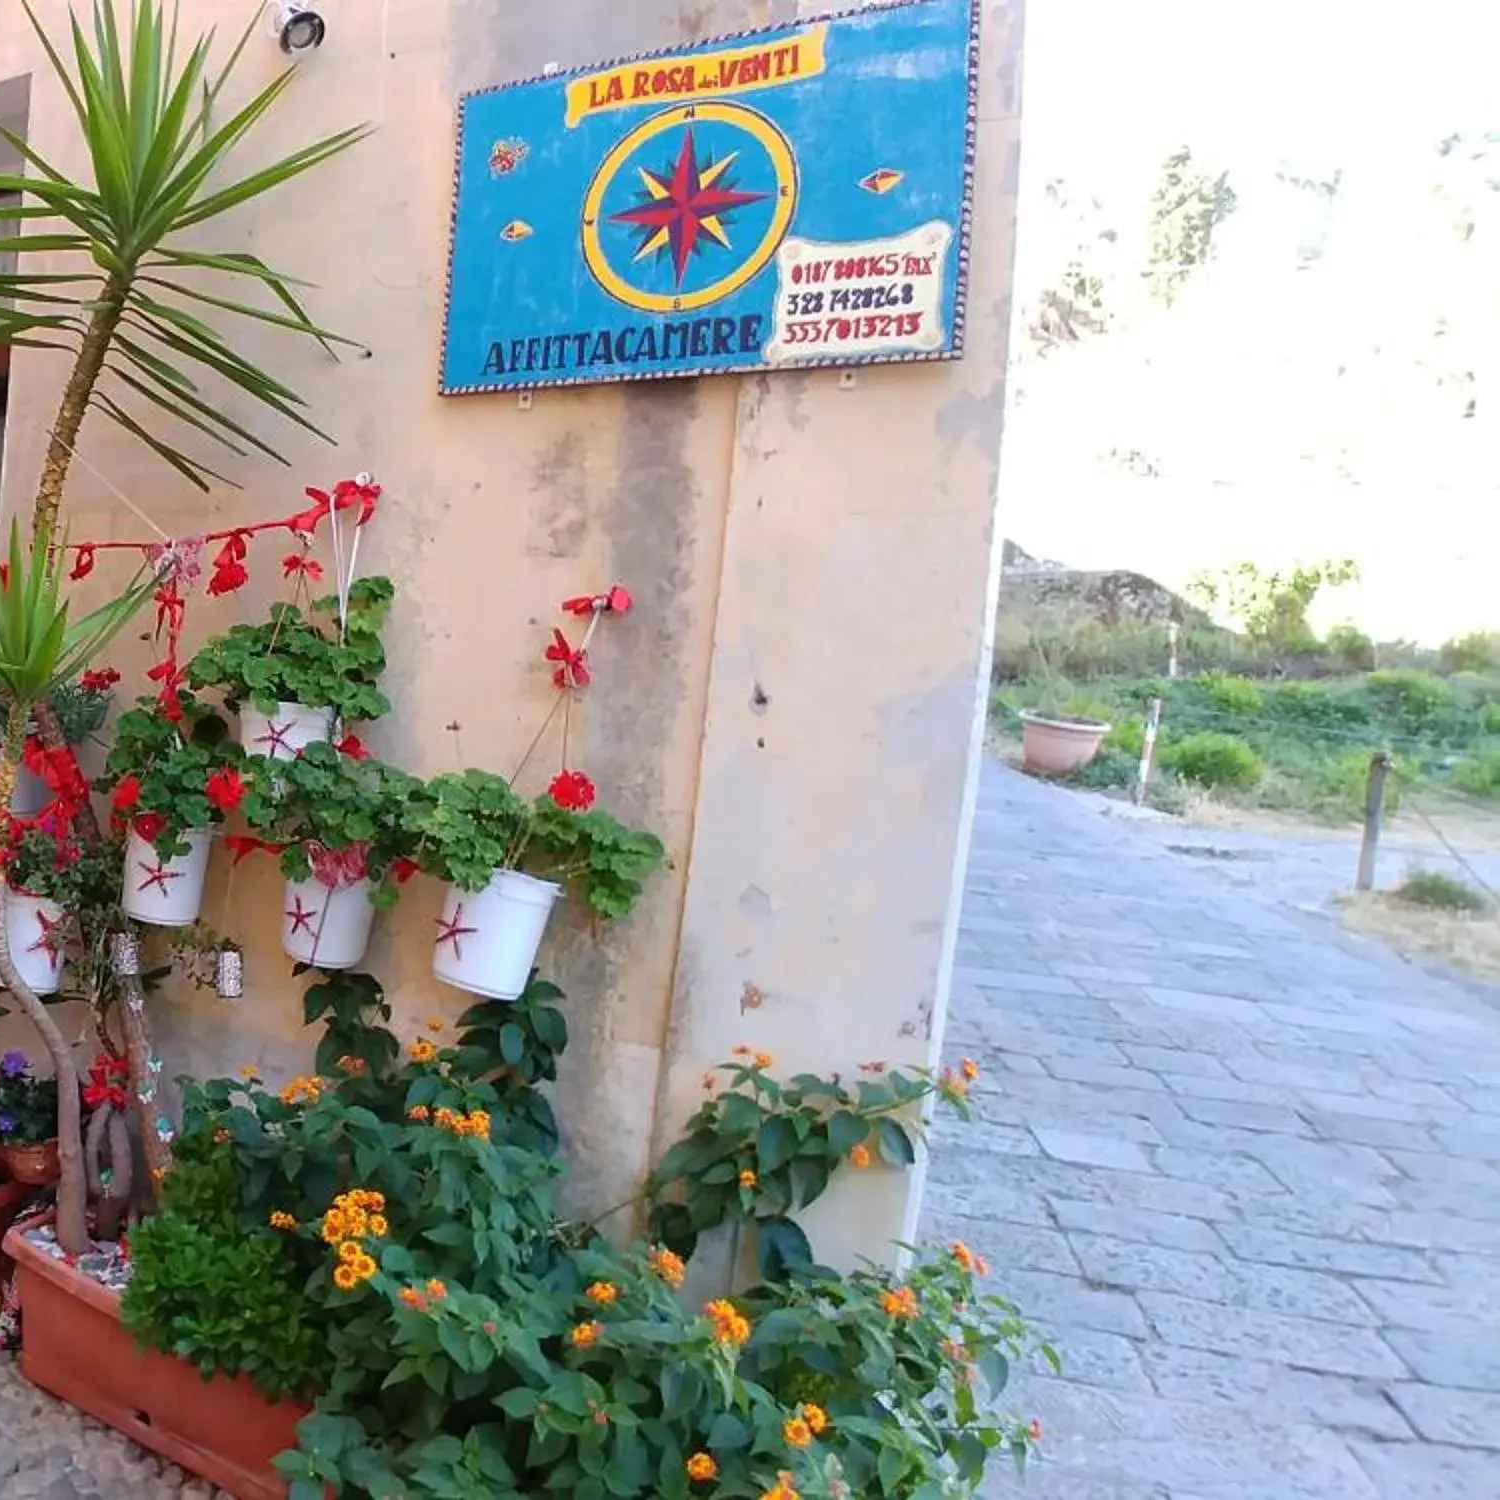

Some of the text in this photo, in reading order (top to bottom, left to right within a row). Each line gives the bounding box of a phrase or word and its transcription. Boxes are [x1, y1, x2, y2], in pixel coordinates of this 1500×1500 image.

[589, 75, 624, 108] LA
[632, 65, 695, 99] ROSA
[719, 44, 799, 88] VENTI
[791, 259, 832, 284] 0187
[786, 292, 825, 315] 328
[481, 314, 763, 376] AFFITTACAMERE
